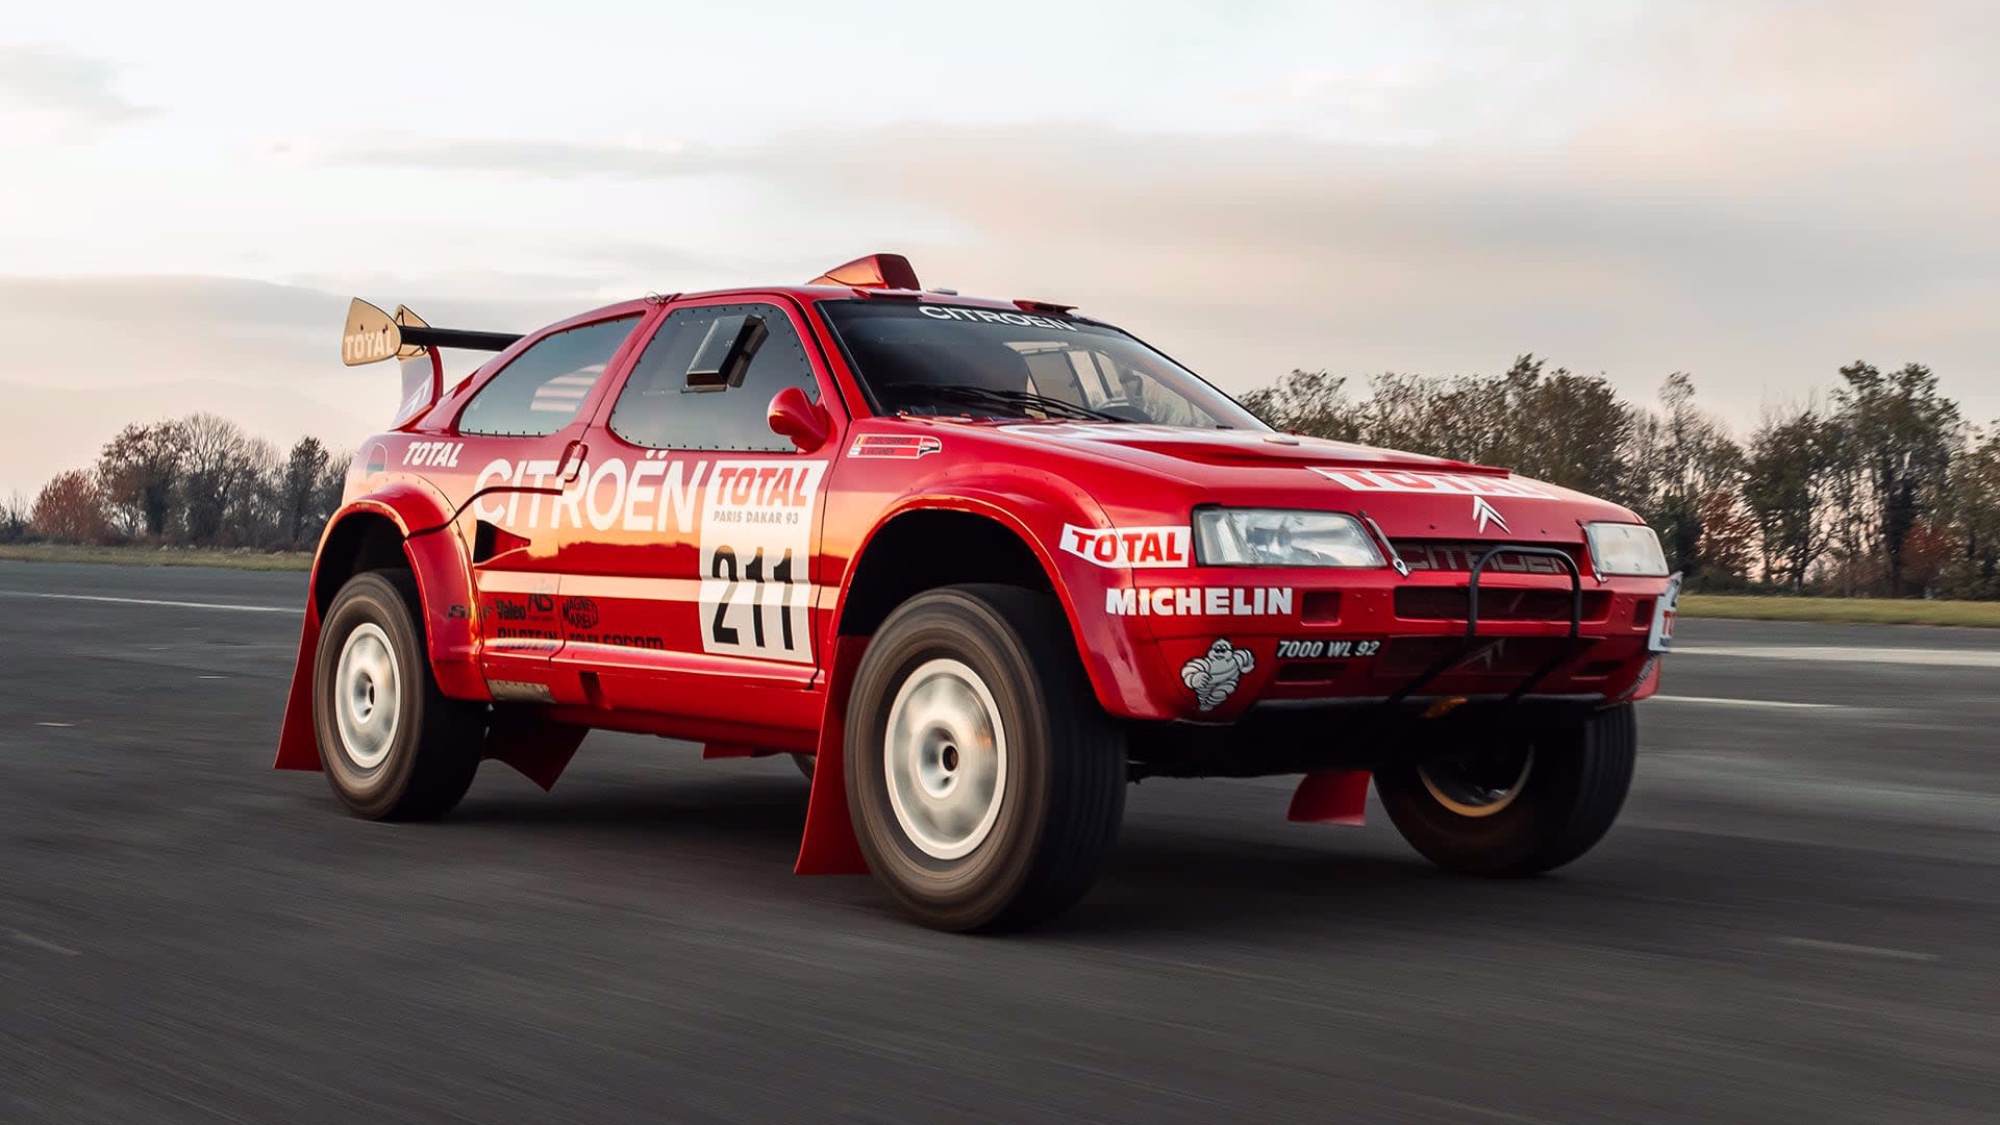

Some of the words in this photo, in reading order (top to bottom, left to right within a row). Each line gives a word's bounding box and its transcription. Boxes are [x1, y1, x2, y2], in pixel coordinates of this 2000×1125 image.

[402, 441, 465, 468] TOTAL
[473, 450, 708, 534] CITROËN
[716, 467, 810, 508] TOTAL
[713, 510, 742, 523] PARIS
[746, 511, 782, 525] DAKAR
[786, 512, 799, 525] 93
[1071, 530, 1184, 563] TOTAL
[711, 544, 795, 651] 211
[1105, 587, 1293, 617] MICHELIN
[1276, 641, 1323, 658] 7000
[1328, 641, 1352, 657] WL
[1355, 640, 1380, 657] 92
